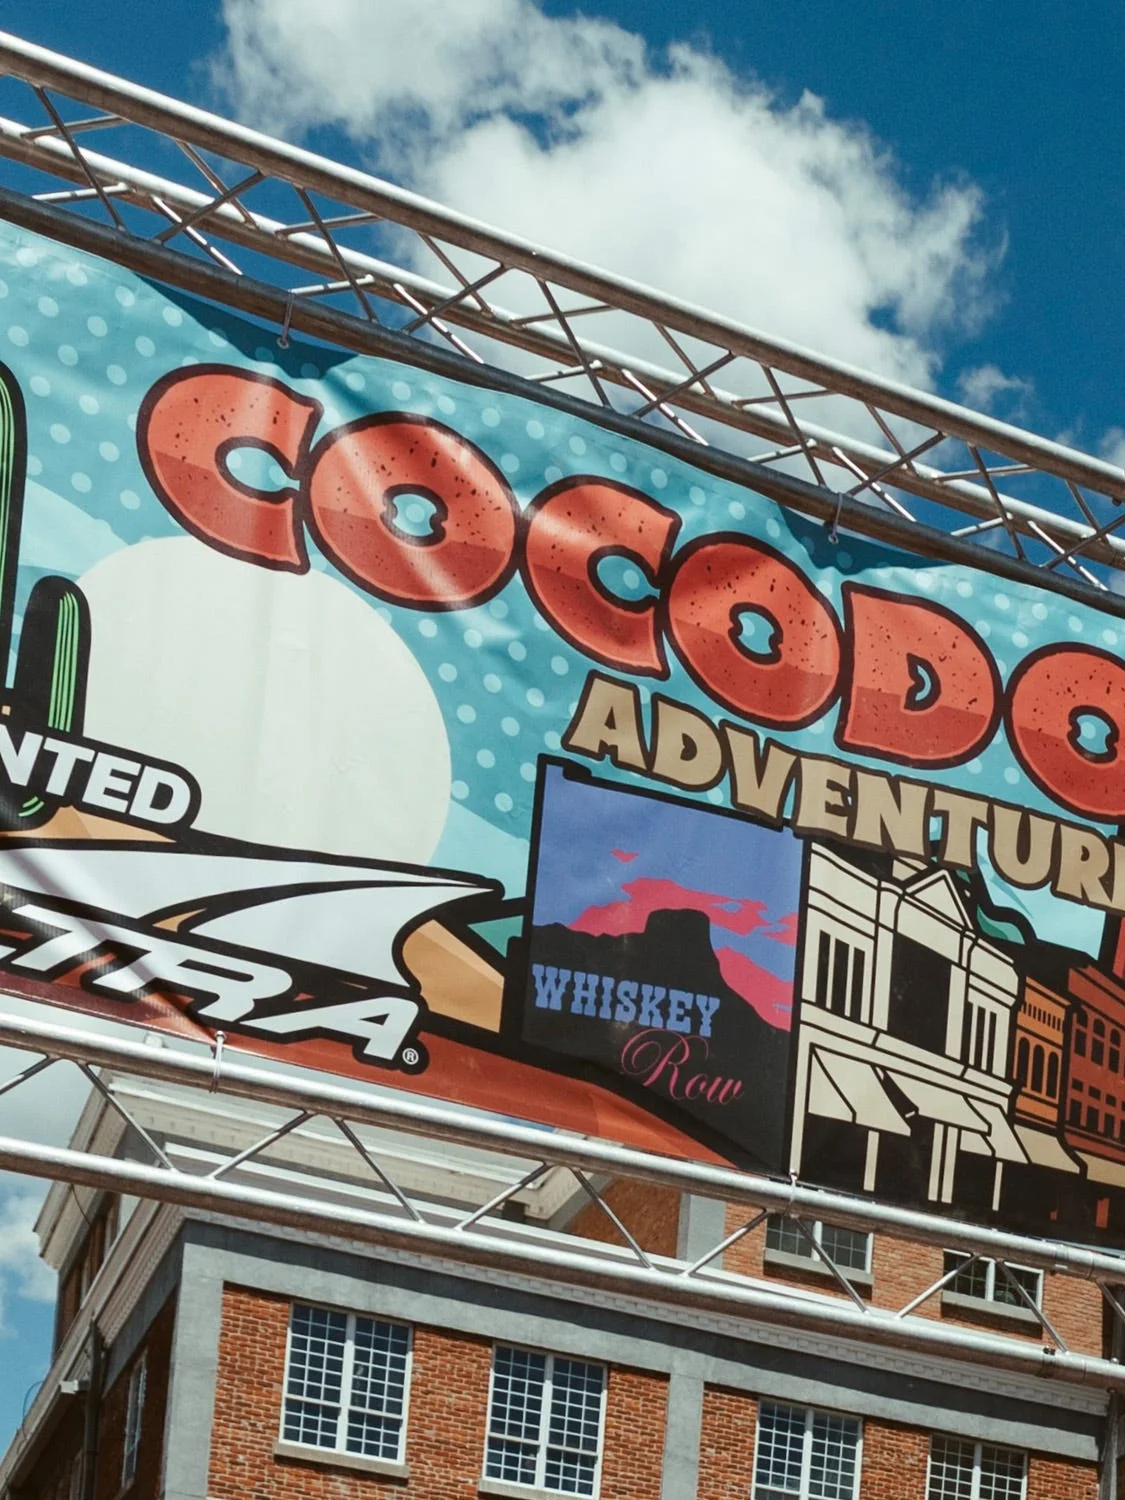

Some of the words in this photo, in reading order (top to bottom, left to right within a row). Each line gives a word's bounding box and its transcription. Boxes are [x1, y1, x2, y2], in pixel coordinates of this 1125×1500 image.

[0, 903, 419, 1066] TRA
[532, 963, 720, 1037] WHISKEY
[619, 1028, 745, 1105] Row
